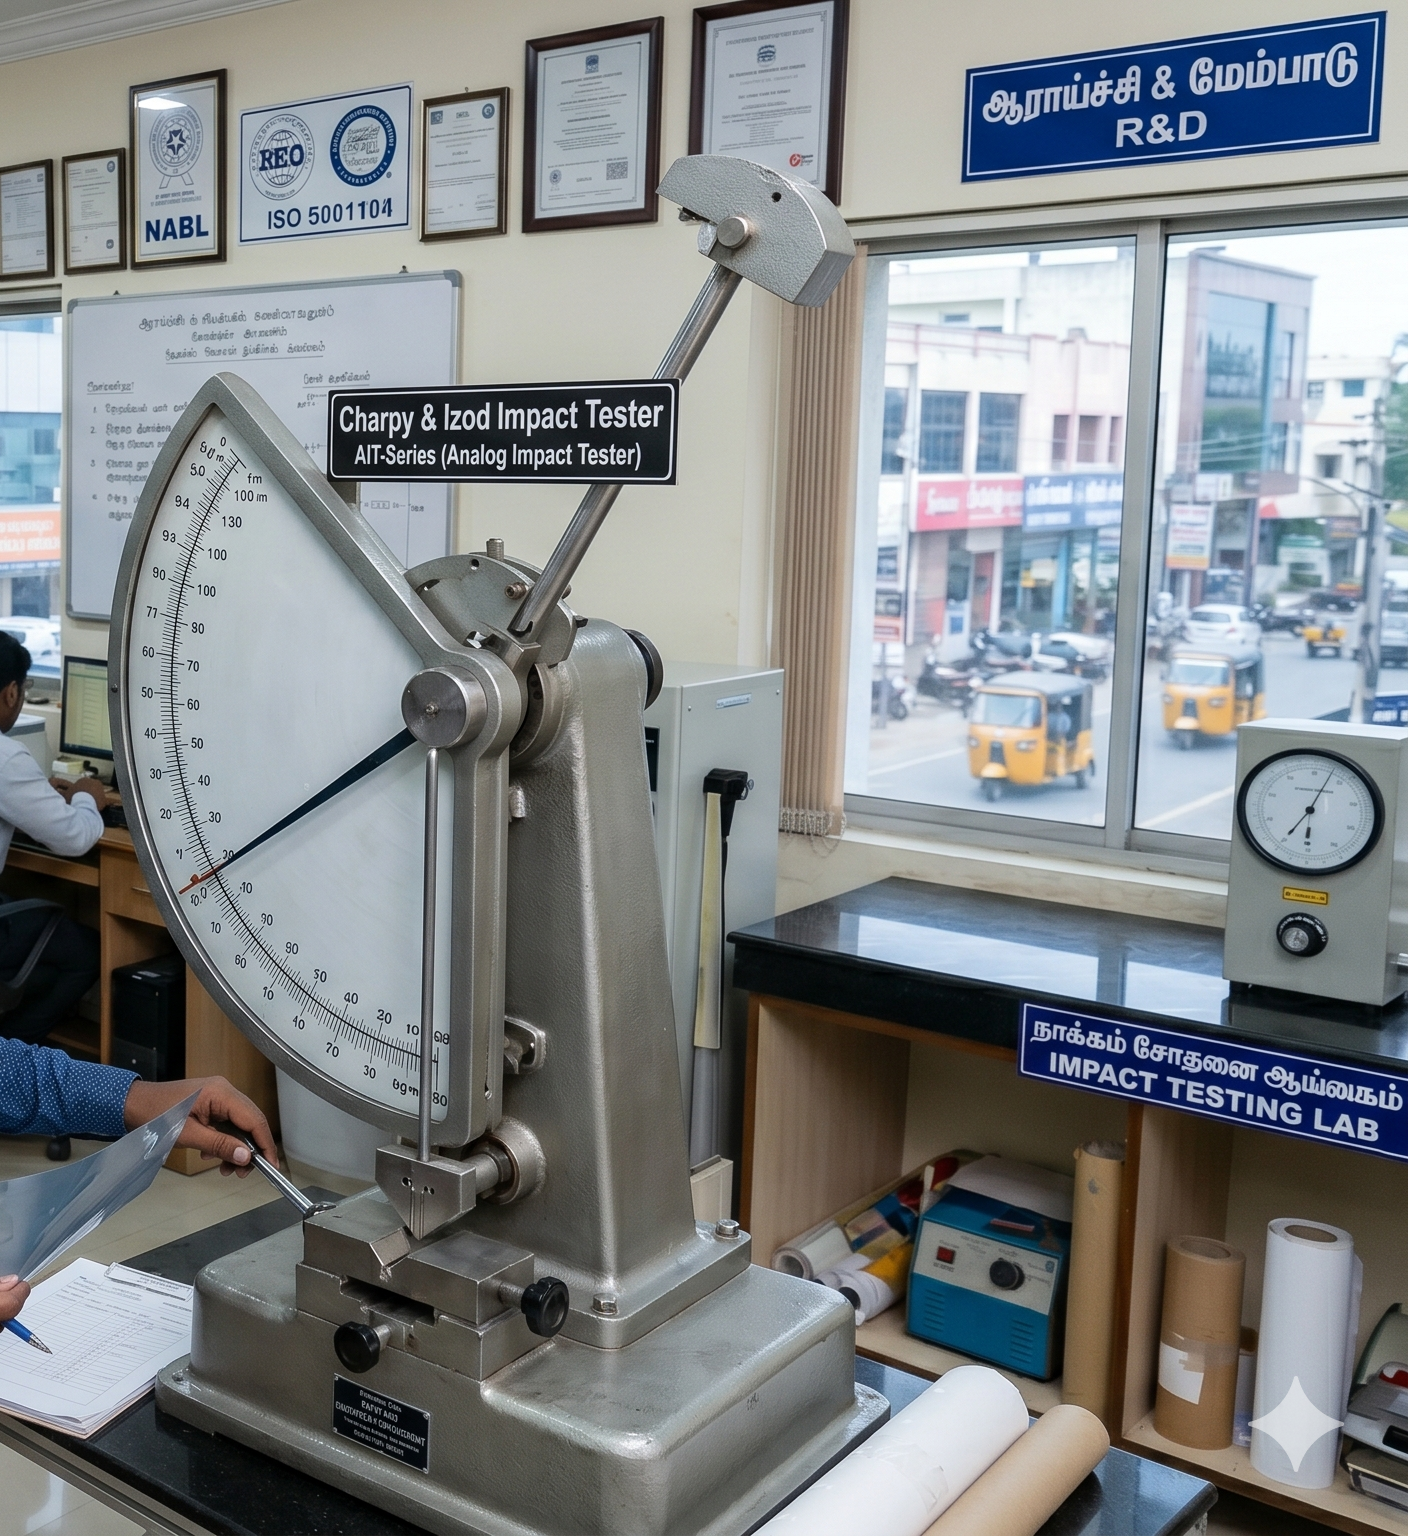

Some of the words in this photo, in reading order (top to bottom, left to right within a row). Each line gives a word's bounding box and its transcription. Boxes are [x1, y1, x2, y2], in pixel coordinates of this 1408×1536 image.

[982, 65, 1140, 126] ஆராய்ச்சி
[1151, 65, 1176, 100] &
[1189, 41, 1358, 96] மேம்பாடு
[1115, 110, 1207, 148] R&D
[268, 208, 302, 230] ISO
[145, 214, 209, 243] NABL
[339, 405, 414, 439] Charpy
[421, 403, 437, 432] &
[444, 401, 491, 431] Izod
[498, 401, 578, 436] Impact
[585, 398, 664, 429] Tester
[220, 436, 227, 447] 0
[354, 443, 436, 465] AIT-Series
[441, 443, 507, 471] (Analog
[512, 444, 572, 471] Impact
[577, 442, 642, 471] Tester)
[234, 489, 254, 502] 100
[222, 516, 242, 528] 130
[208, 548, 227, 561] 100
[197, 584, 216, 597] 100
[142, 645, 155, 658] 60
[187, 659, 200, 672] 70
[141, 686, 153, 699] 50
[187, 698, 200, 711] 60
[144, 727, 156, 739] 40
[191, 737, 204, 749] 50
[149, 768, 162, 780] 30
[197, 774, 211, 786] 40
[159, 808, 172, 820] 20
[208, 811, 221, 823] 30
[234, 954, 247, 969] 60
[343, 992, 359, 1004] 40
[292, 1015, 305, 1030] 40
[377, 1009, 392, 1024] 20
[406, 1024, 420, 1036] 10
[325, 1042, 339, 1058] 70
[1030, 1020, 1126, 1054] நாக்கம்
[1133, 1034, 1259, 1082] சோதனை
[363, 1065, 376, 1079] 30
[432, 1092, 447, 1107] 80
[1049, 1052, 1158, 1094] IMPACT
[1166, 1076, 1303, 1126] TESTING
[1313, 1108, 1379, 1143] LAB
